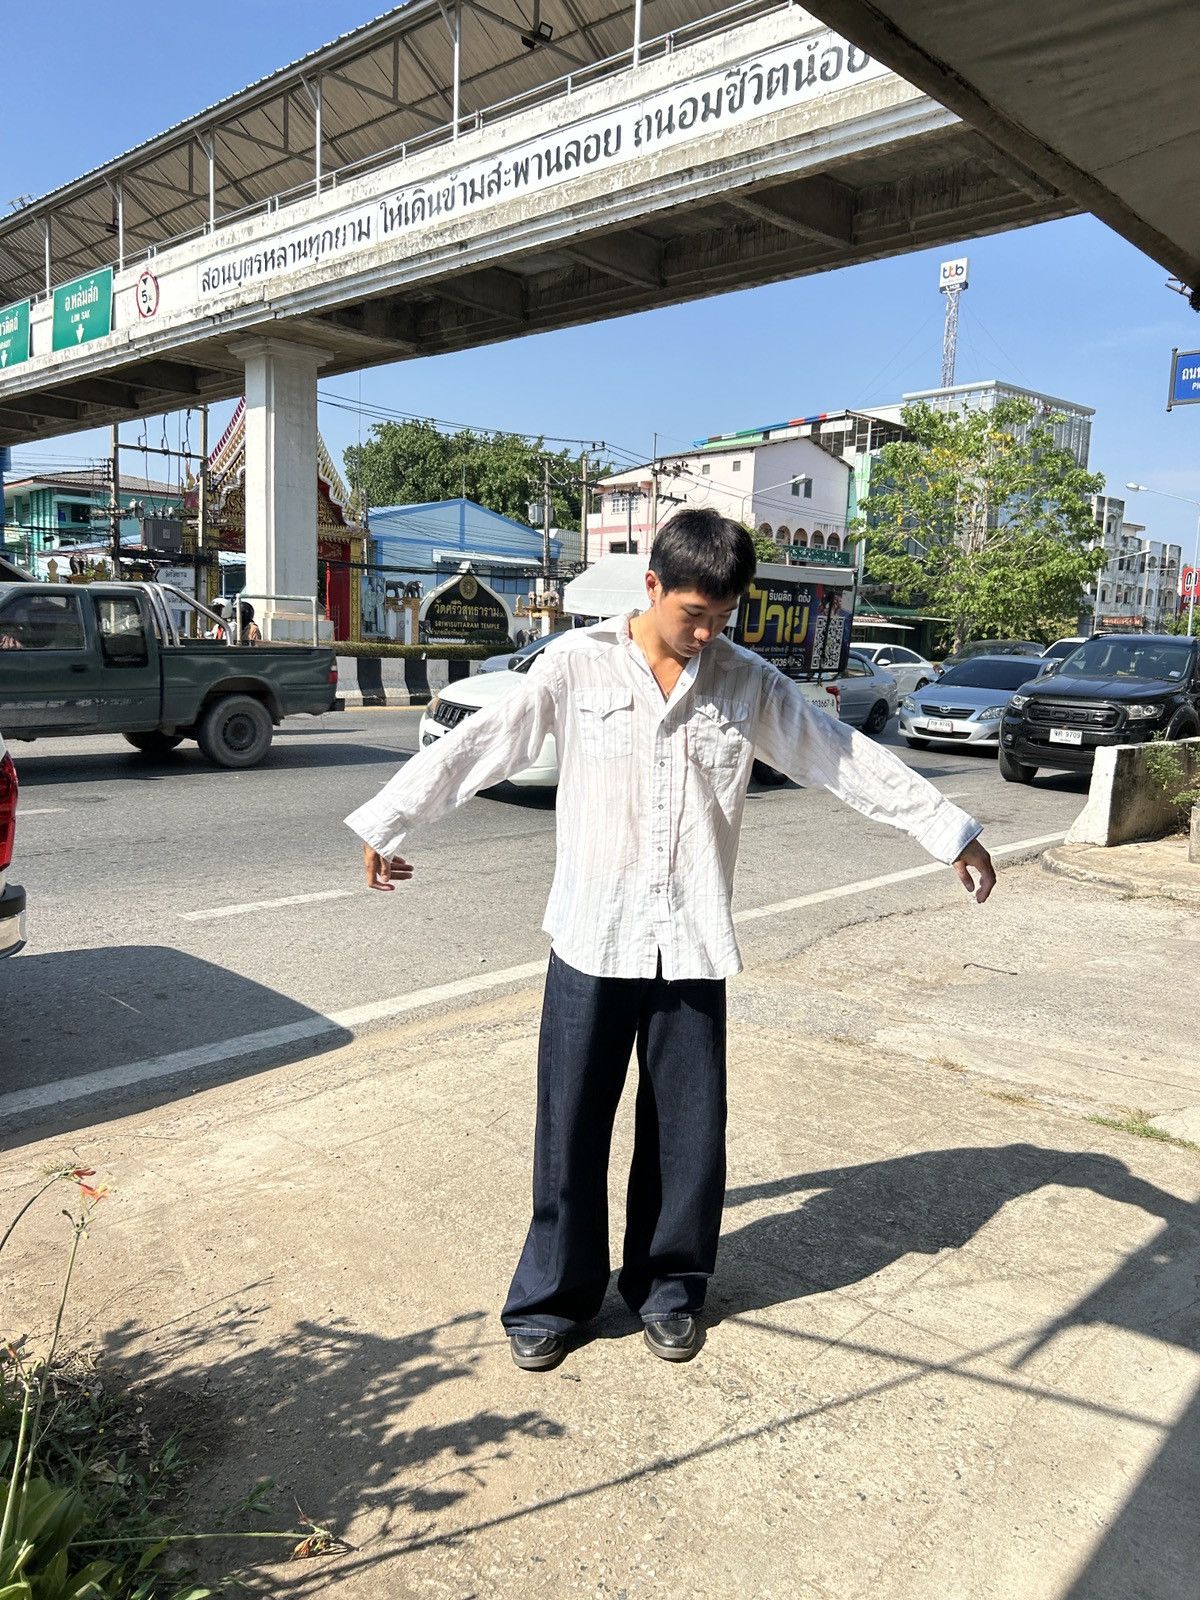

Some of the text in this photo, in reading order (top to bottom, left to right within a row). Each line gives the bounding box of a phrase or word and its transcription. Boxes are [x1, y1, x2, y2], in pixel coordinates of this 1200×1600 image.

[201, 216, 371, 291] สอนบุตรหลานทุกยาม
[379, 124, 621, 233] ให้เดินข้ามสะพานลอย
[943, 264, 964, 279] ttb
[65, 280, 99, 312] อ.หล่มสัก
[0, 310, 19, 336] รดิตถ์
[1181, 367, 1200, 381] ถน
[435, 621, 500, 630] SRIWISUTTARAM TEMPLE
